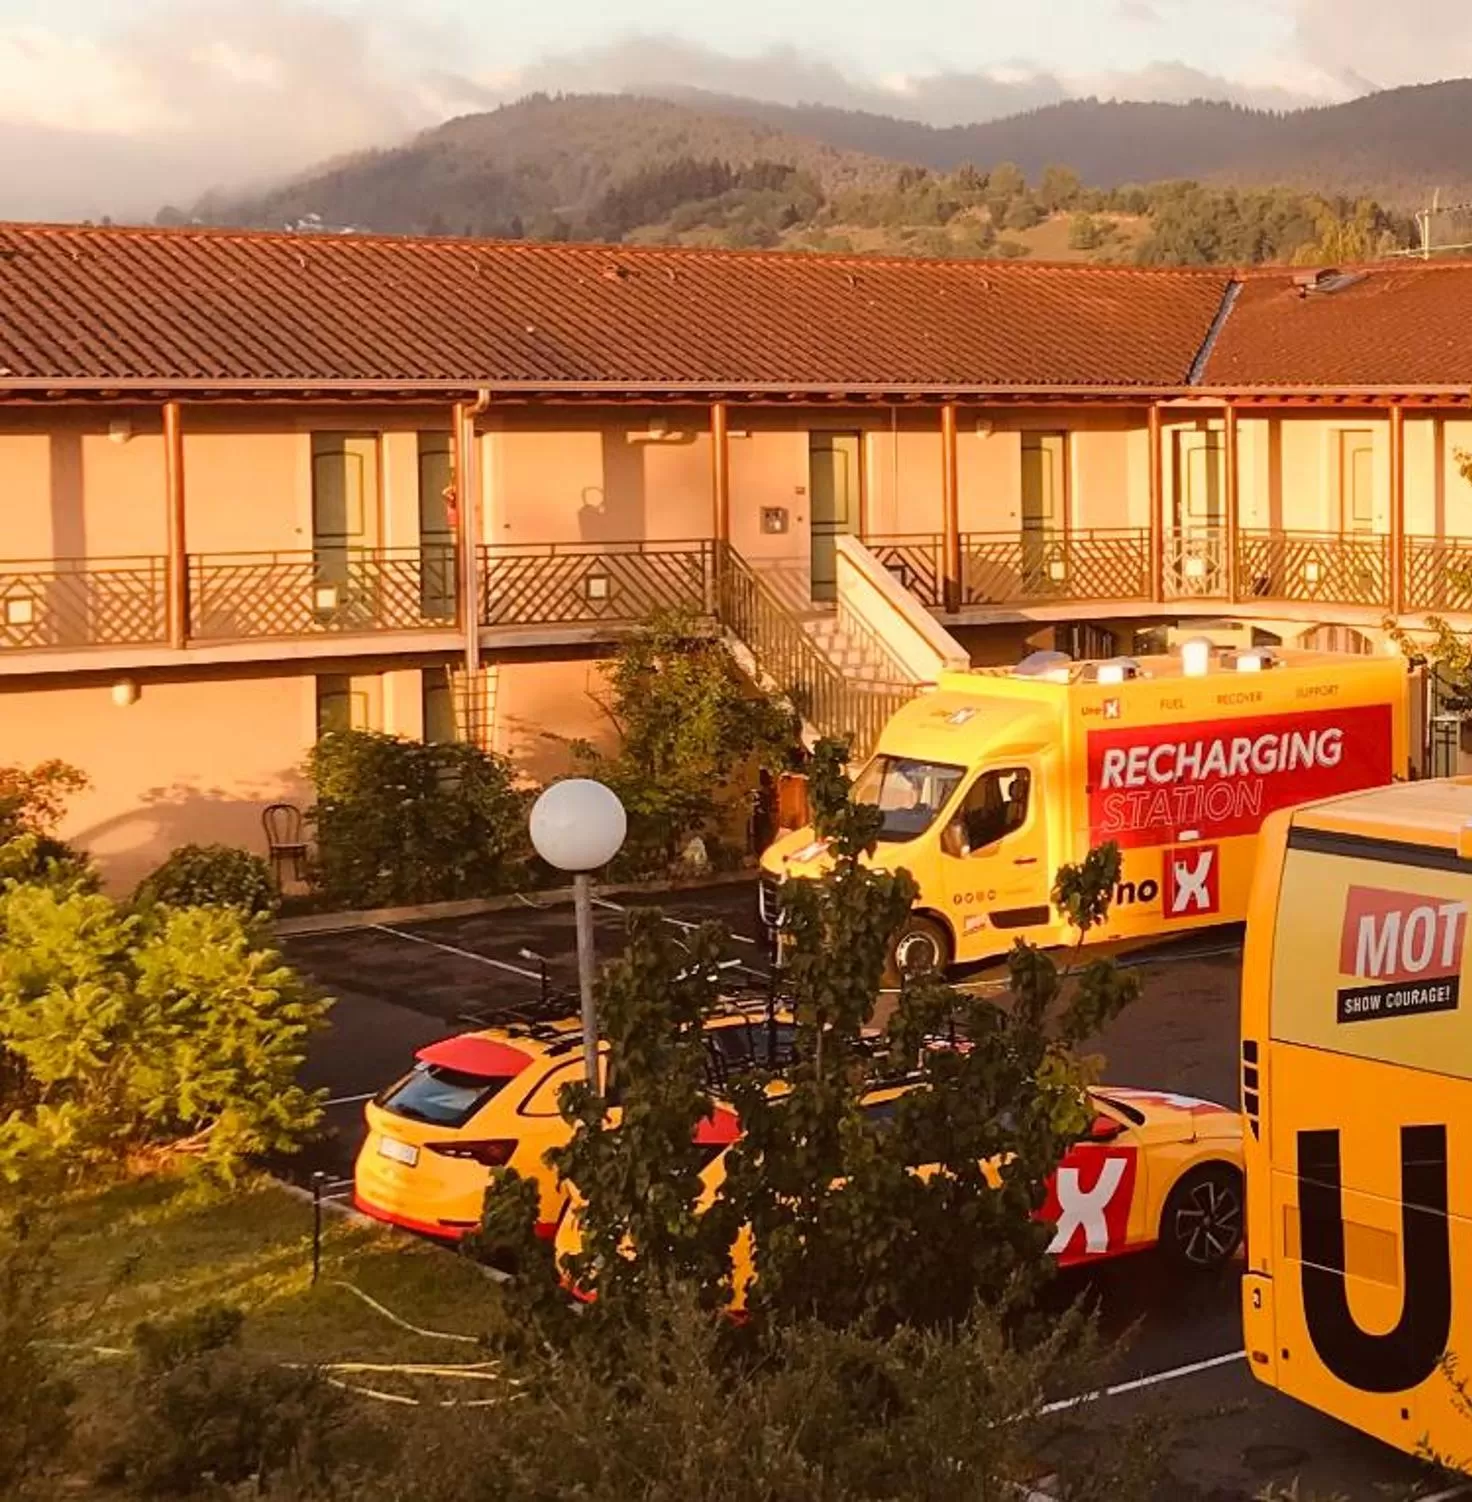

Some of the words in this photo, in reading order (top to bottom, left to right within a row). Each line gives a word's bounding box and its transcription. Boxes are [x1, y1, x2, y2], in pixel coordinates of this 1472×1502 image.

[1160, 699, 1186, 710] FUEL
[1216, 691, 1263, 705] RECOVER
[1296, 684, 1340, 698] SUPPORT
[1101, 728, 1343, 789] RECHARGING
[1103, 779, 1263, 832] STATION
[1115, 880, 1158, 905] no
[1356, 901, 1471, 977] MOT
[1344, 996, 1381, 1014] SHOW
[1386, 985, 1450, 1008] COURAGE!
[1045, 1158, 1128, 1253] X
